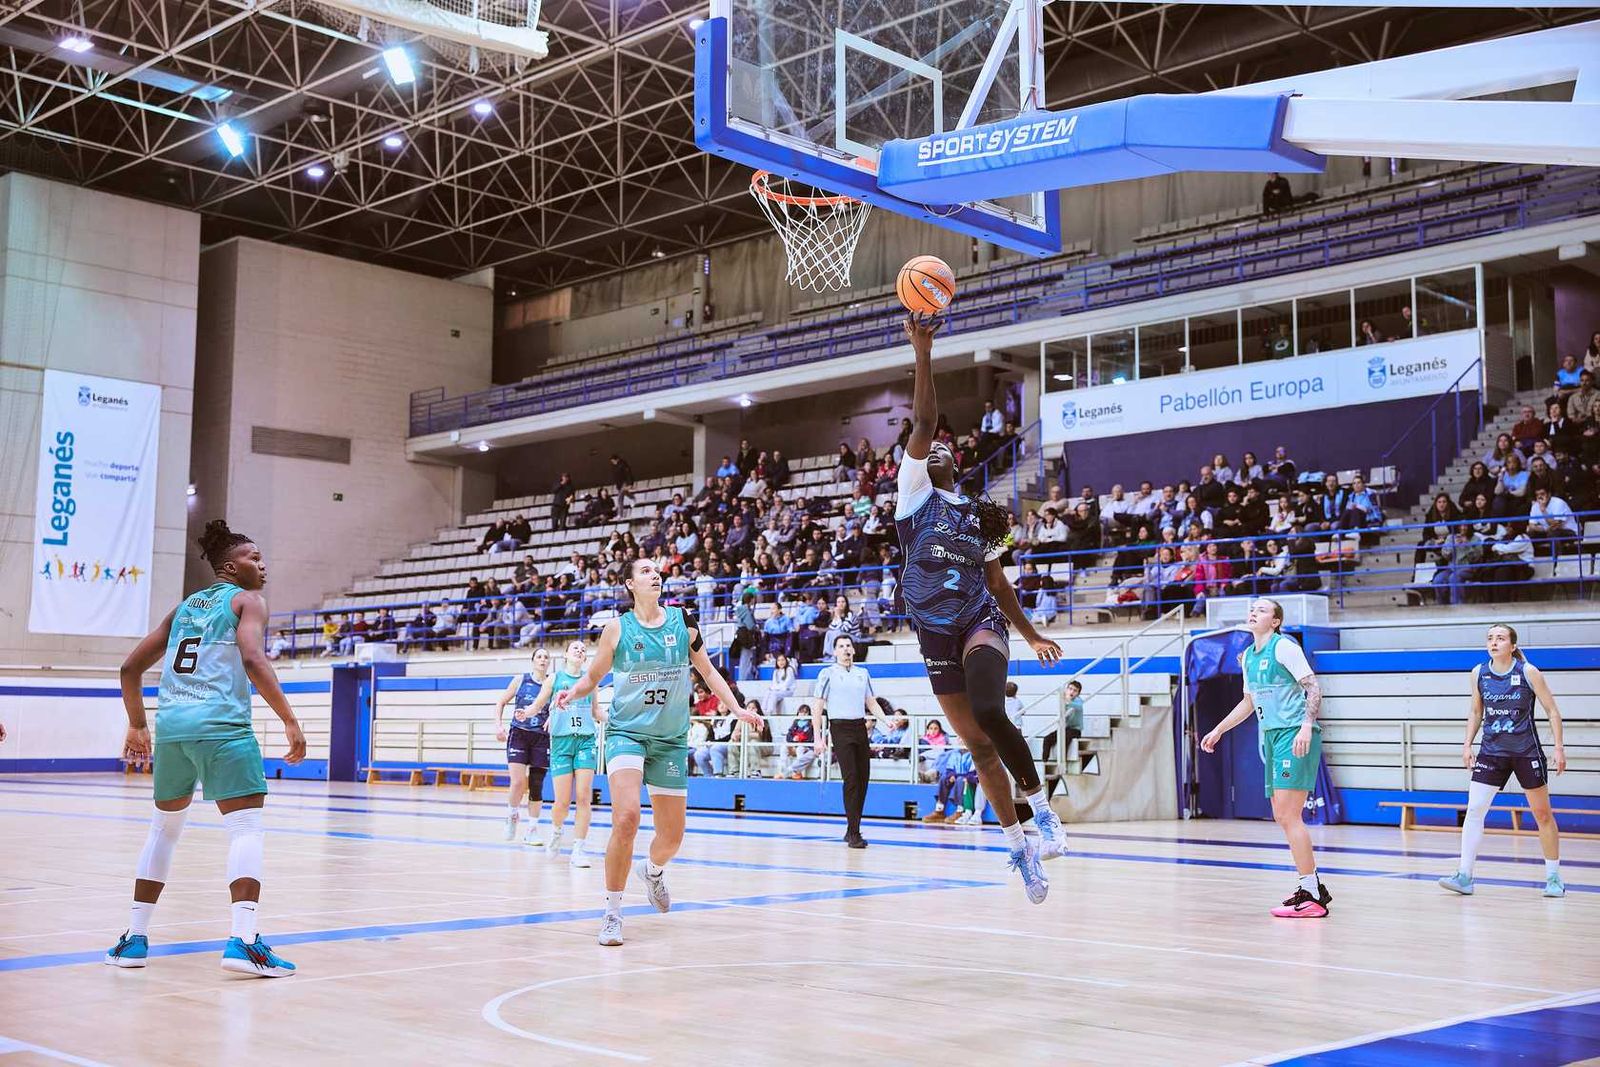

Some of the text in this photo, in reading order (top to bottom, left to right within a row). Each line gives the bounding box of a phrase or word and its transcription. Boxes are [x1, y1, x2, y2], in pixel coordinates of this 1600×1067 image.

[1389, 357, 1448, 377] Leganés
[92, 392, 129, 406] Leganés
[1160, 376, 1325, 413] Pabellón Europa
[1079, 402, 1124, 419] Leganés
[43, 431, 76, 546] Leganés
[943, 569, 961, 591] 2
[172, 636, 203, 676] 6
[644, 688, 668, 705] 33
[571, 716, 583, 727] 15
[1491, 720, 1515, 734] 44
